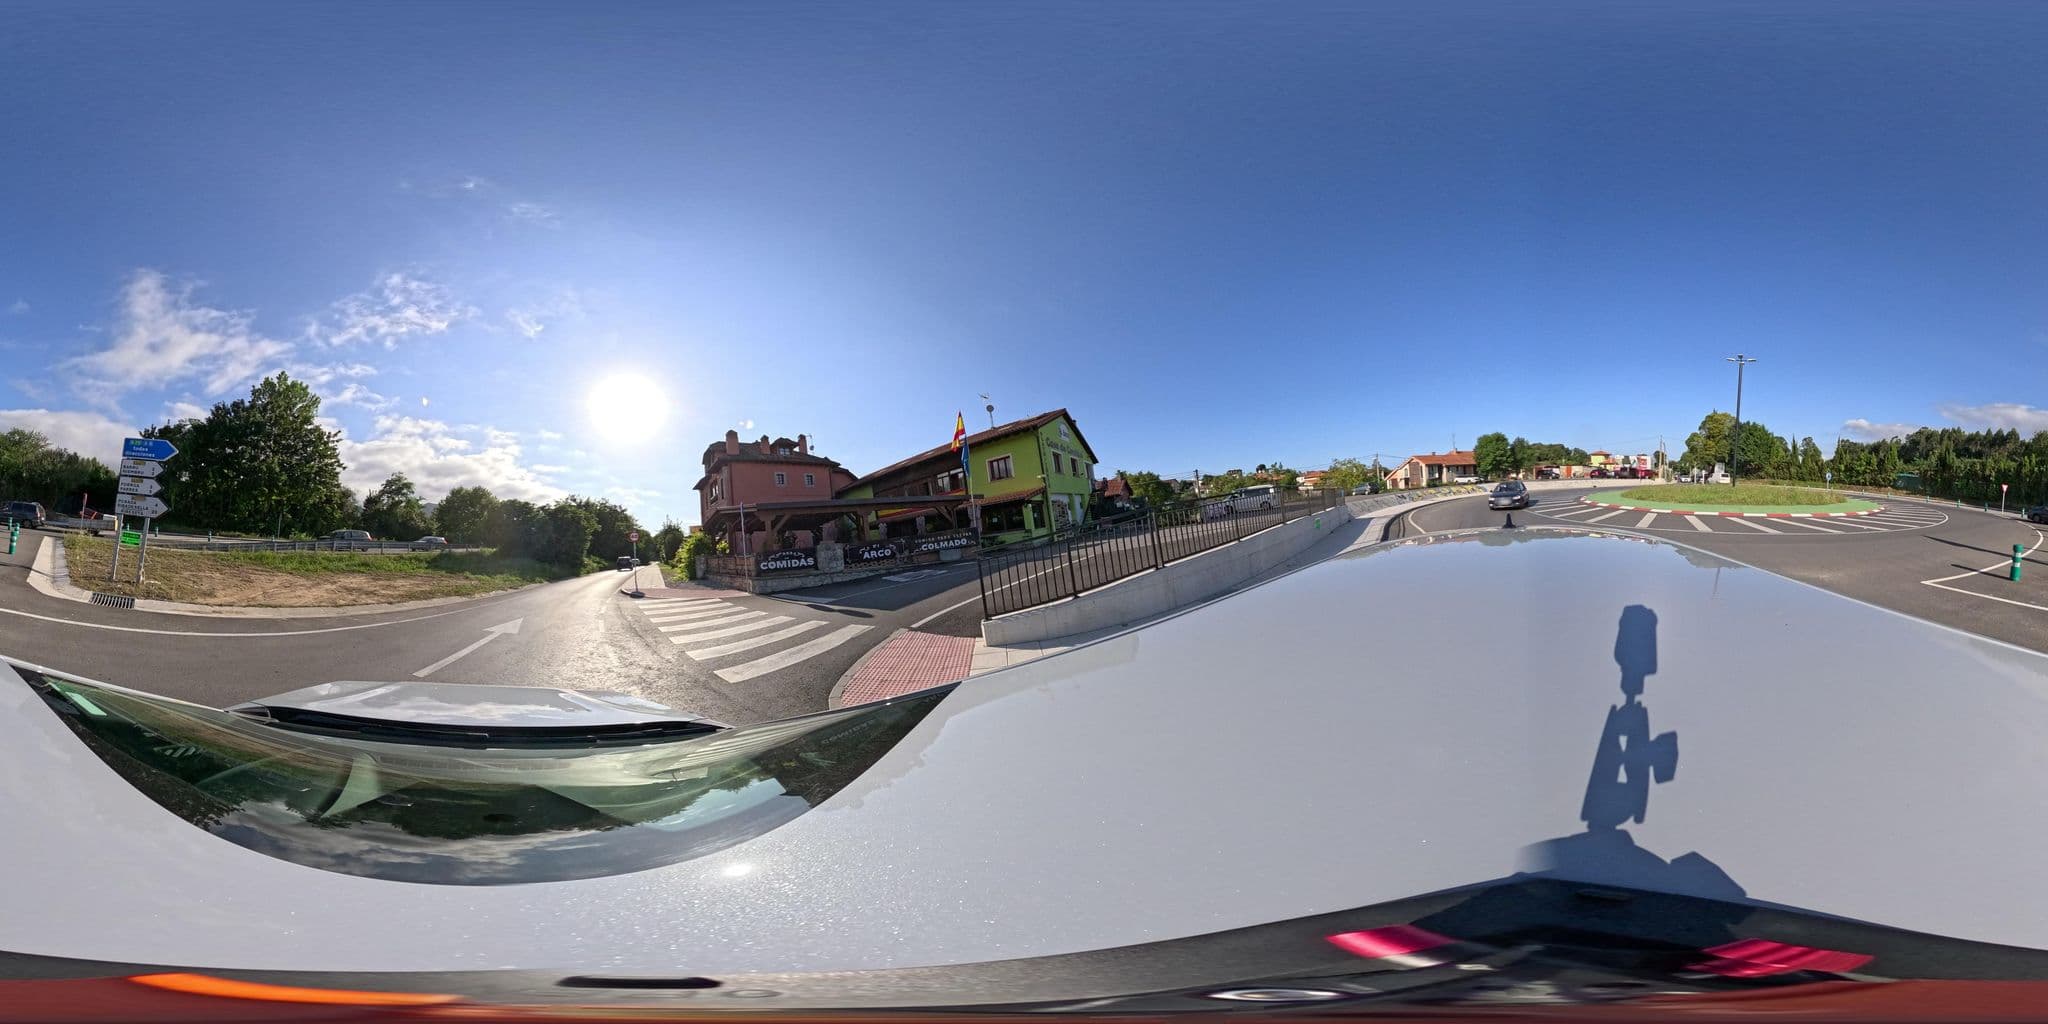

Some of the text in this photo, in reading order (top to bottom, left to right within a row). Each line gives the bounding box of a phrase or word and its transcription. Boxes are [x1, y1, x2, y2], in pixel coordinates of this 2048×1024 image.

[921, 538, 967, 551] COLMADO
[863, 548, 892, 560] ARCO
[760, 557, 815, 570] COMIDAS
